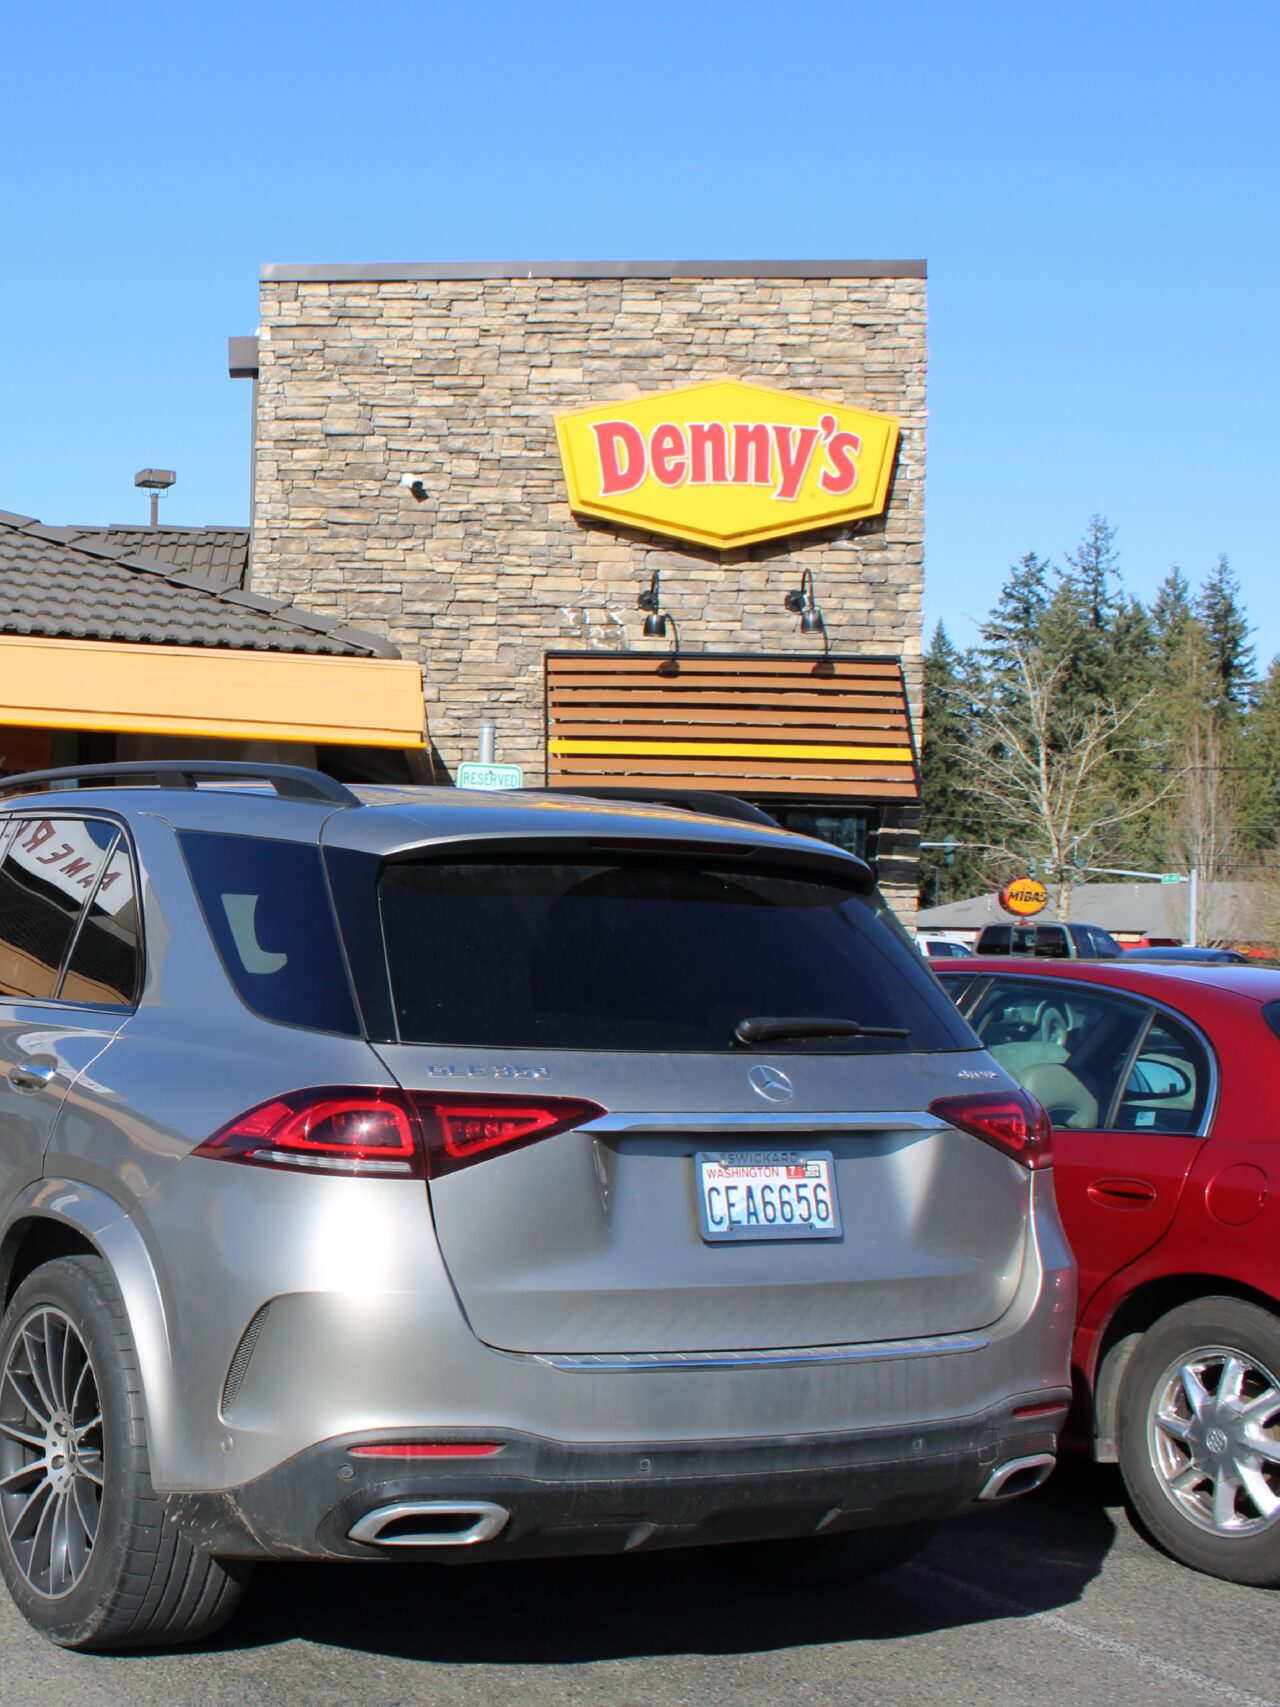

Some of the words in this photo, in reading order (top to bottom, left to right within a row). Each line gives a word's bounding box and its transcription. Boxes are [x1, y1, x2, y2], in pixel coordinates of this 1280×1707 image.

[588, 414, 862, 502] Denny's
[463, 771, 518, 787] RESERVED
[1008, 891, 1048, 903] MIDAS
[727, 1152, 800, 1164] SWICKARD
[706, 1166, 780, 1179] WASHINGTON
[707, 1183, 830, 1225] CEA6656
